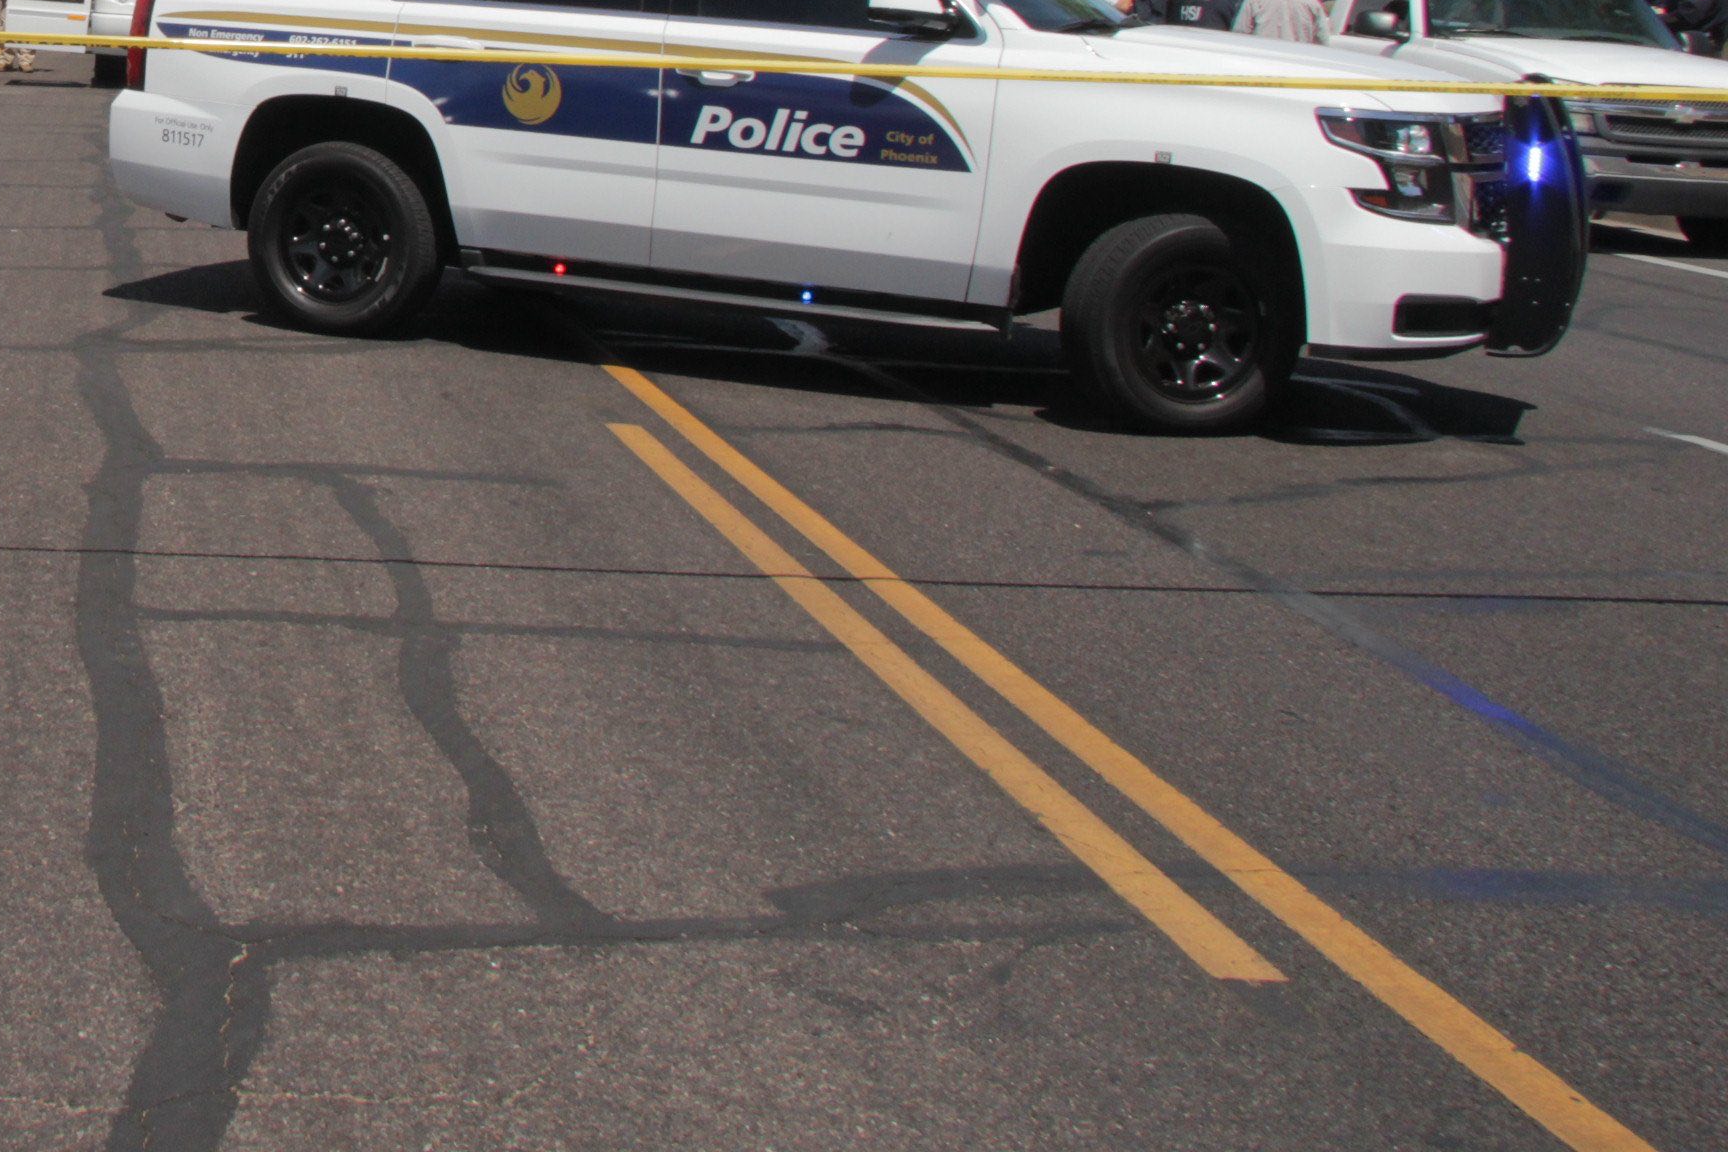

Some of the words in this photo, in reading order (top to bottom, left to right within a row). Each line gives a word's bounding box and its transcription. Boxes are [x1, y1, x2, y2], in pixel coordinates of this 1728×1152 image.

[1181, 5, 1202, 20] HSI
[188, 27, 209, 38] Non
[210, 29, 265, 43] Emergency
[161, 128, 204, 148] 811517
[690, 105, 866, 158] Police
[886, 130, 915, 145] City
[918, 132, 934, 145] of
[880, 148, 939, 165] Phoenix
